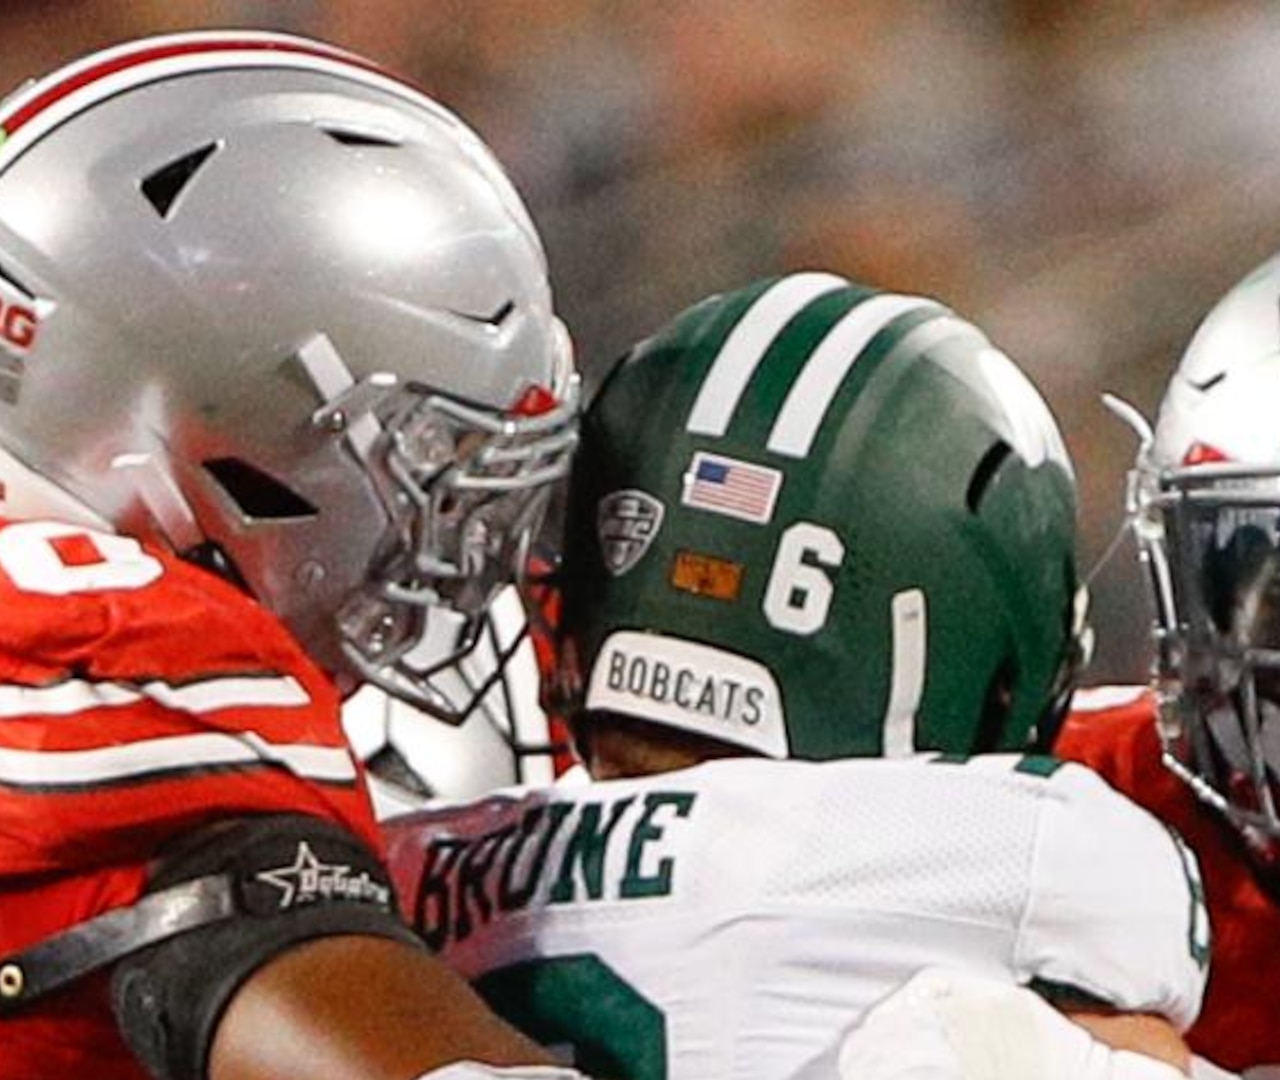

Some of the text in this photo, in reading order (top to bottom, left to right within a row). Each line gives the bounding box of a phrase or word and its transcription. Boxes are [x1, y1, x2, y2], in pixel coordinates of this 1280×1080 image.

[764, 521, 846, 636] 6
[609, 650, 764, 725] BOBCATS
[414, 792, 697, 951] BRUNE
